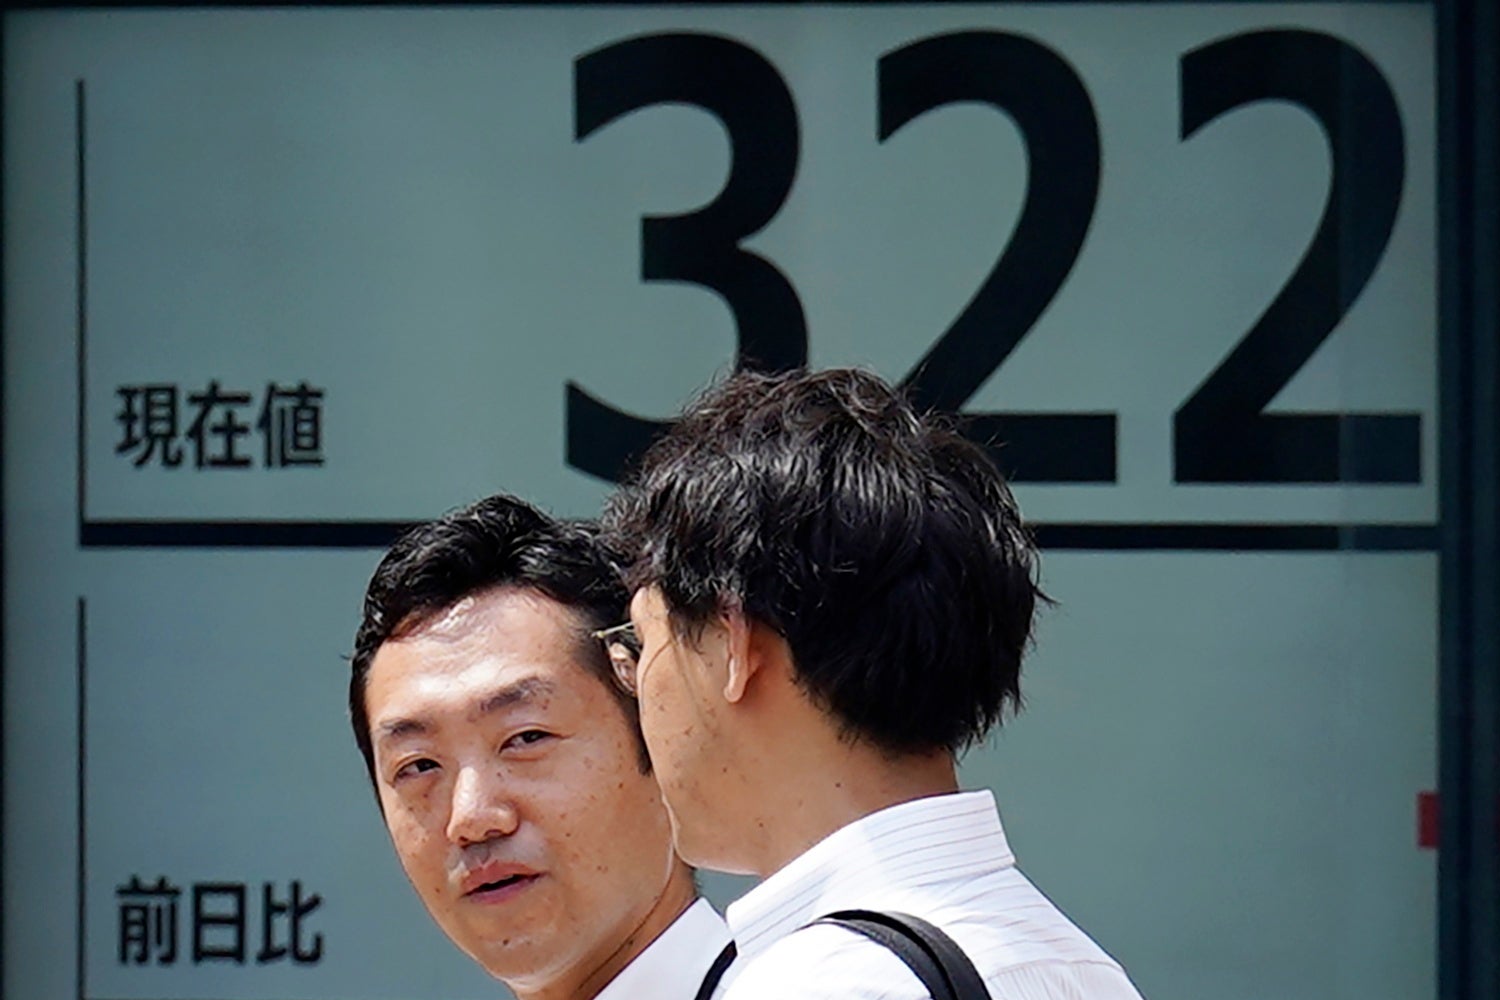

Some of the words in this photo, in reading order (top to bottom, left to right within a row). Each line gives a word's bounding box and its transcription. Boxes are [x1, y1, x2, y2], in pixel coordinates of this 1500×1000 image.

[116, 380, 325, 470] 現在値
[115, 874, 325, 966] 前日比
